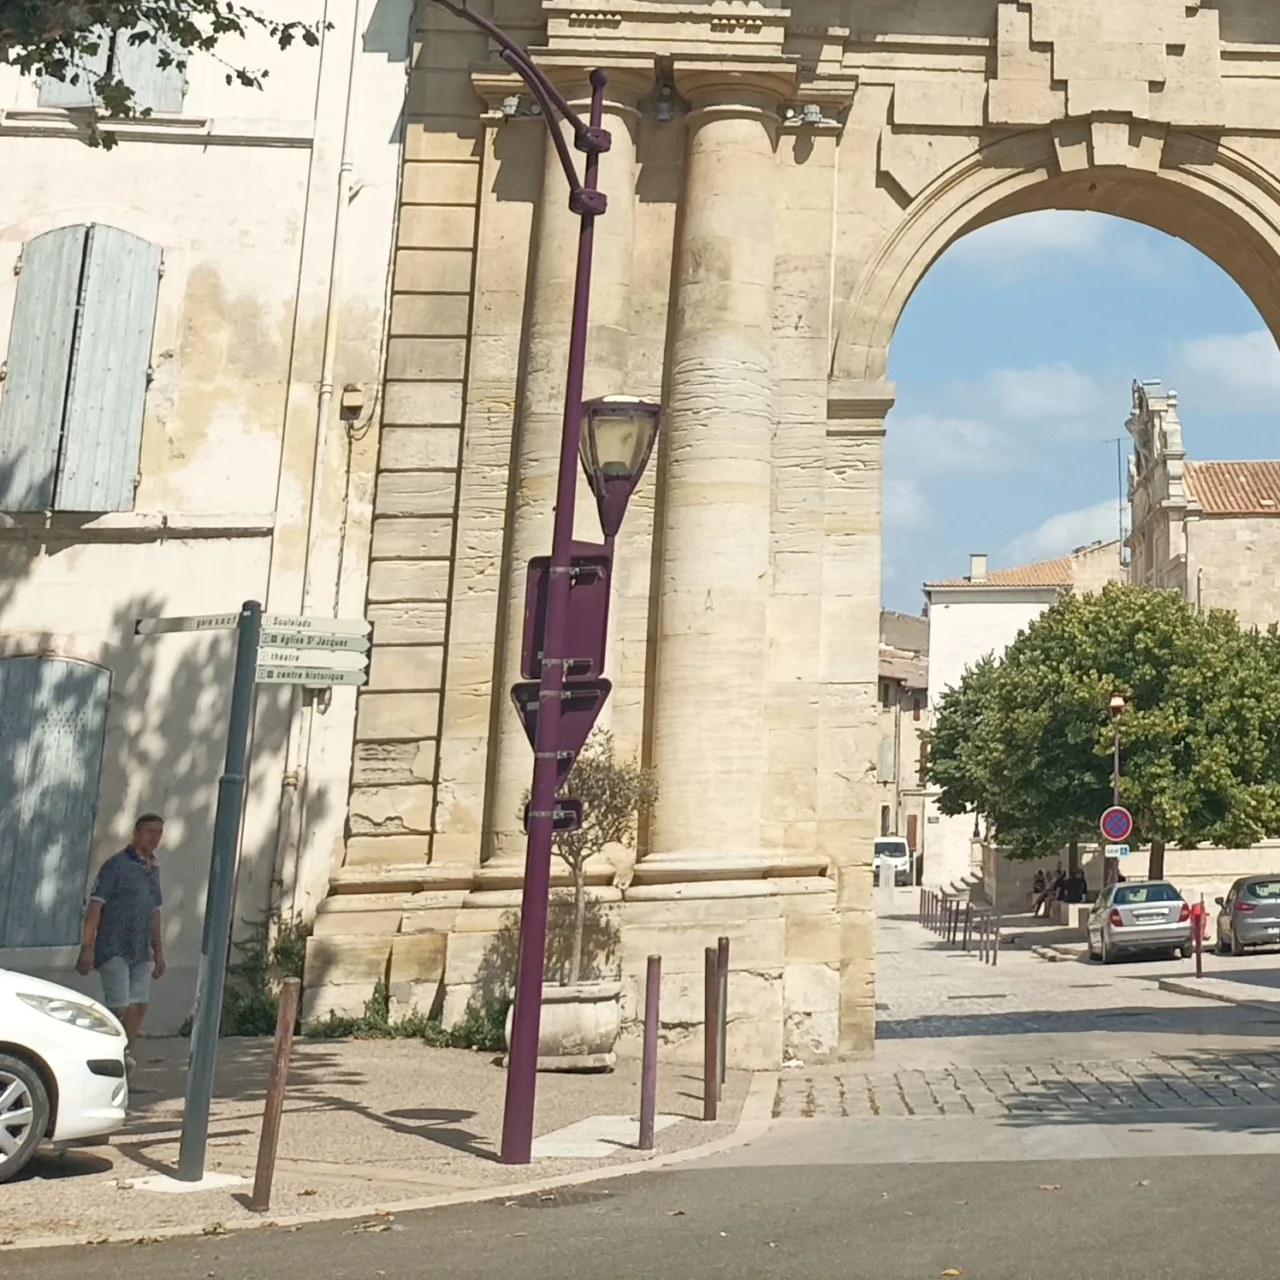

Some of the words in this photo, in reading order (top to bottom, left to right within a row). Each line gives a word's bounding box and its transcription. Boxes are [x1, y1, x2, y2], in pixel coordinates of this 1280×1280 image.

[196, 619, 213, 629] gare
[280, 634, 304, 646] église
[316, 636, 348, 648] Jacques
[276, 670, 303, 680] centre
[305, 671, 344, 682] historique
